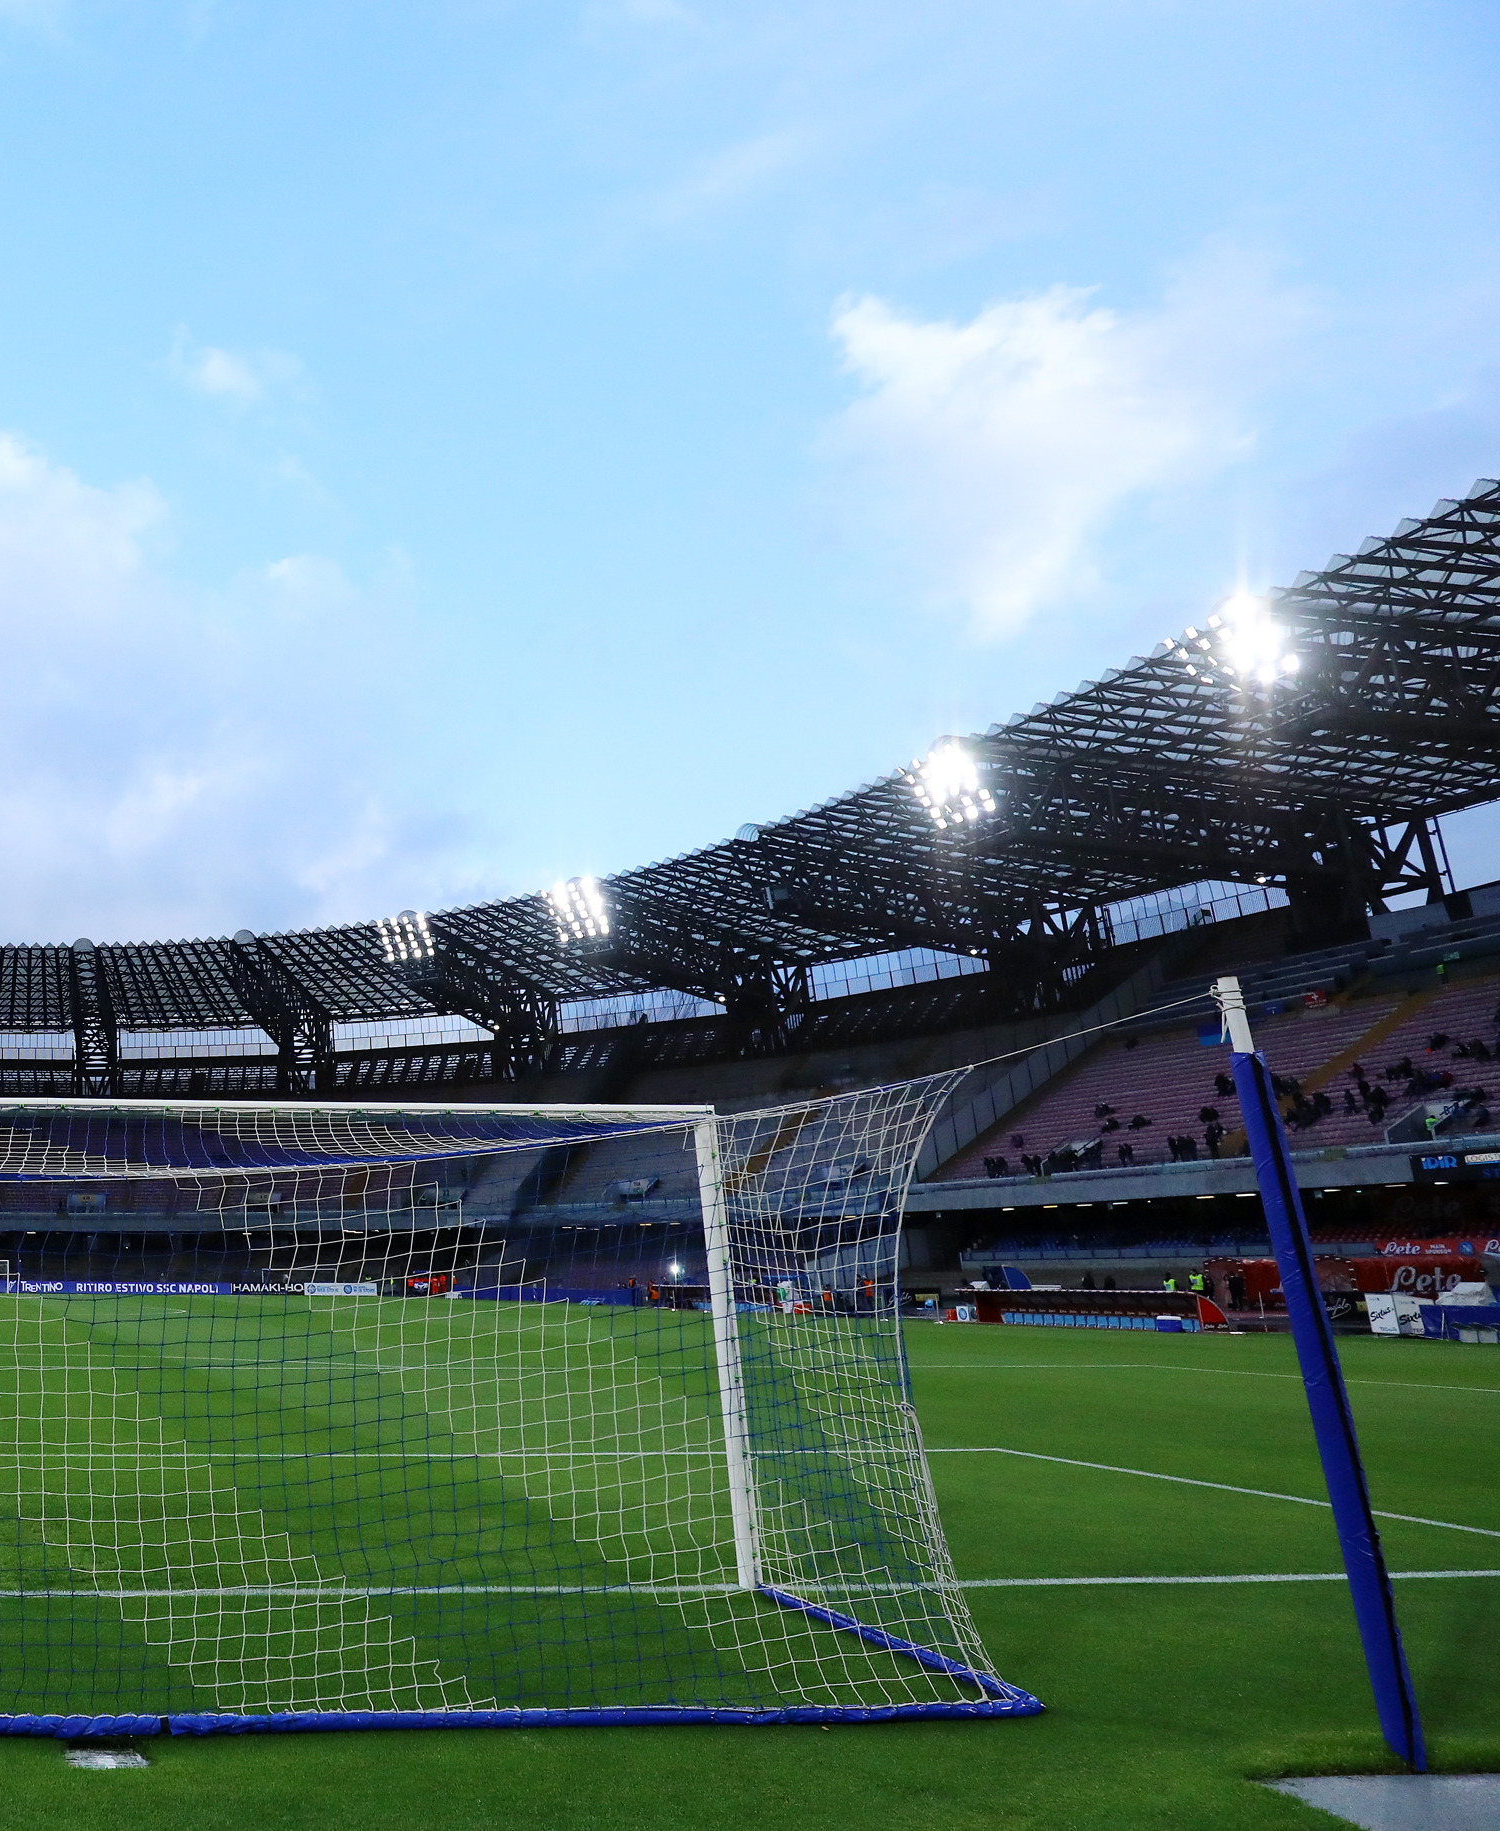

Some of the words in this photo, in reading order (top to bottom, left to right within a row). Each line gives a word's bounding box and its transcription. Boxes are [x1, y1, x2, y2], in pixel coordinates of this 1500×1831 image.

[21, 1281, 63, 1293] TRENTINO
[76, 1283, 113, 1292] RITIRO
[115, 1283, 154, 1292] ESTIVO
[156, 1283, 176, 1293] SSC
[178, 1283, 219, 1293] NAPOLI
[233, 1283, 304, 1293] HAMAKI-HO
